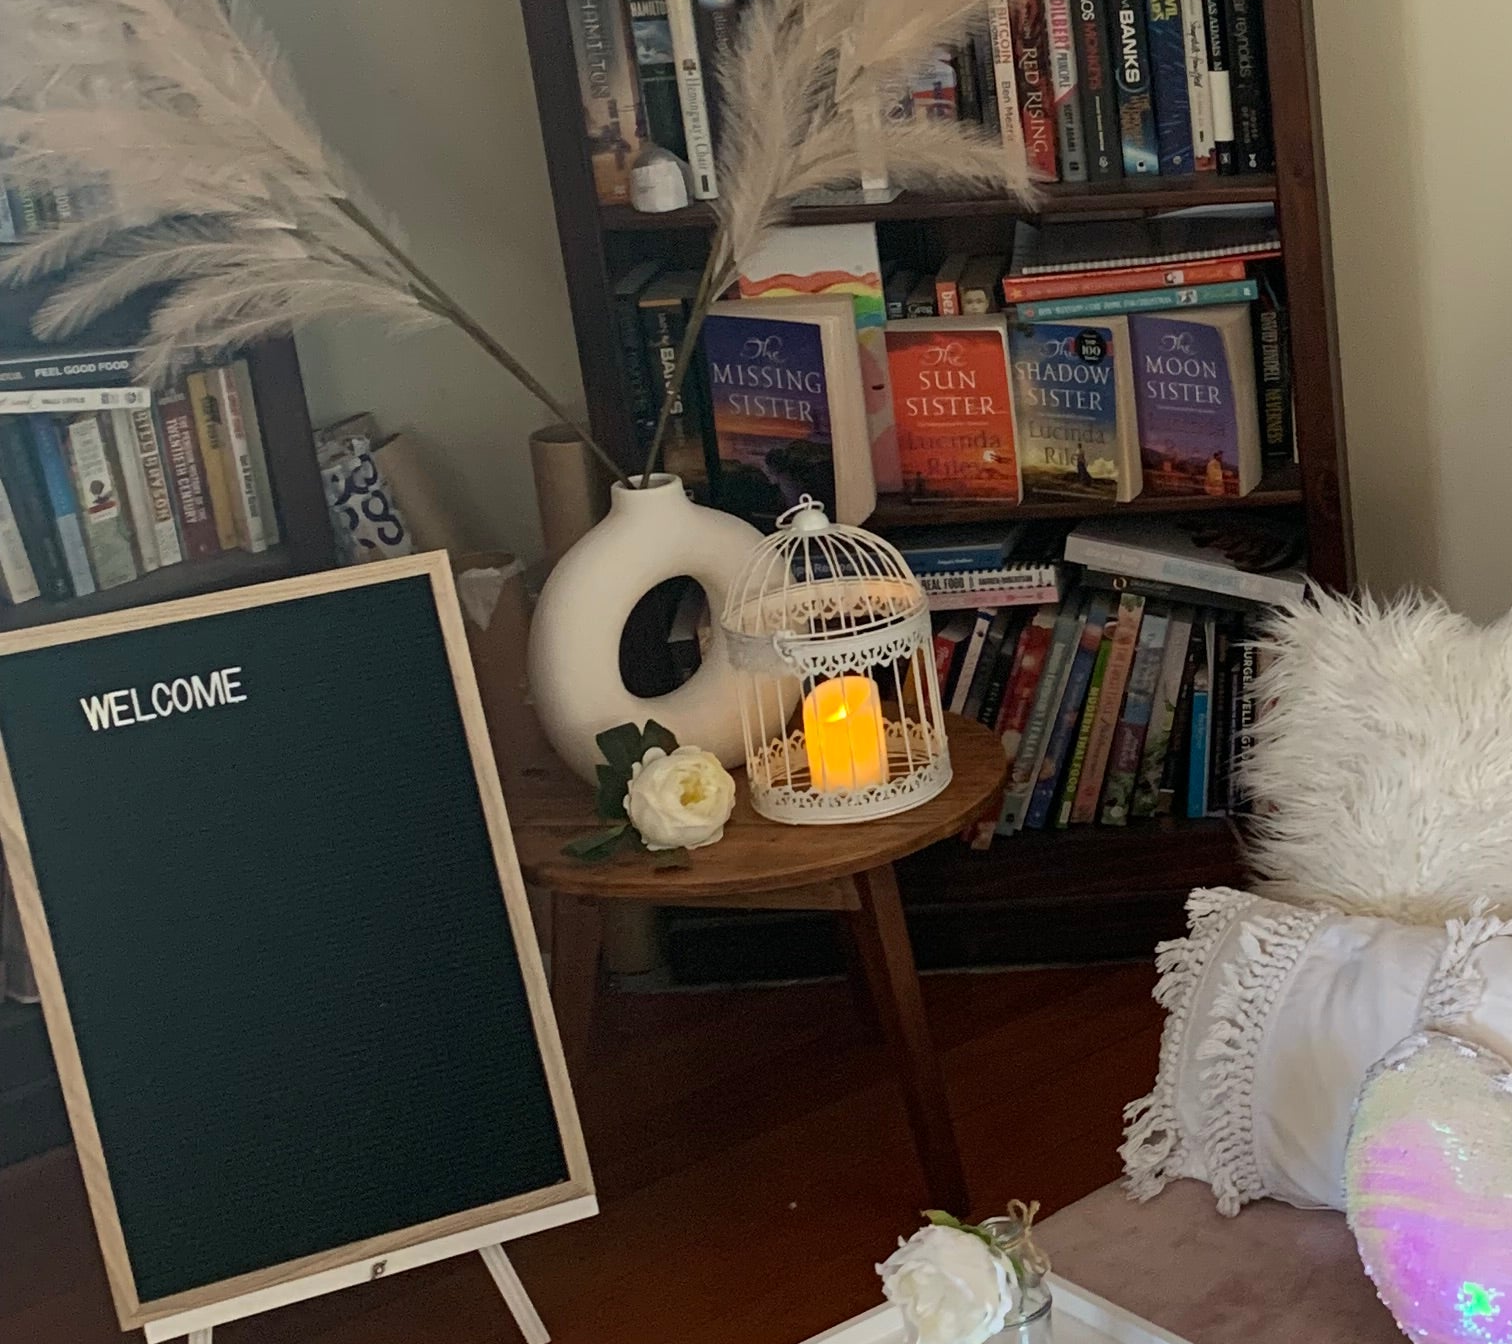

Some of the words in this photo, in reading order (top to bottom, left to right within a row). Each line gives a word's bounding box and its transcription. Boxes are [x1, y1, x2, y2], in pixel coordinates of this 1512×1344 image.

[998, 8, 1012, 65] BITCOIN
[1119, 9, 1141, 83] BANKS
[1209, 17, 1222, 57] ADAMS
[1235, 17, 1250, 78] reynolds
[1018, 47, 1040, 85] RED
[1056, 52, 1072, 88] PRINCIPLE
[1083, 22, 1104, 91] MONKEYS
[1001, 81, 1011, 103] Ben
[683, 76, 701, 141] Hemingway's
[694, 142, 708, 171] Chair
[1023, 92, 1049, 153] RISING
[1261, 312, 1276, 341] DAVID
[741, 335, 786, 363] The
[921, 341, 968, 367] The
[1081, 345, 1101, 357] 100
[1159, 331, 1197, 356] The
[35, 367, 62, 378] FEEL
[64, 364, 96, 375] GOOD
[98, 360, 129, 371] FOOD
[712, 362, 822, 395] MISSING
[919, 369, 976, 391] SUN
[1015, 360, 1112, 386] SHADOW
[1145, 356, 1217, 379] MOON
[905, 396, 996, 417] SISTER
[1025, 387, 1103, 412] SISTER
[1147, 380, 1222, 405] SISTER
[728, 392, 814, 424] SISTER
[905, 430, 1001, 452] Lucinda
[1029, 420, 1105, 444] Lucinda
[166, 418, 186, 476] TWENTIETH
[178, 477, 199, 524] CENTURY
[922, 577, 942, 590] REAL
[944, 576, 964, 589] FOOD
[80, 667, 247, 731] WELCOME
[1083, 687, 1099, 733] MODERN
